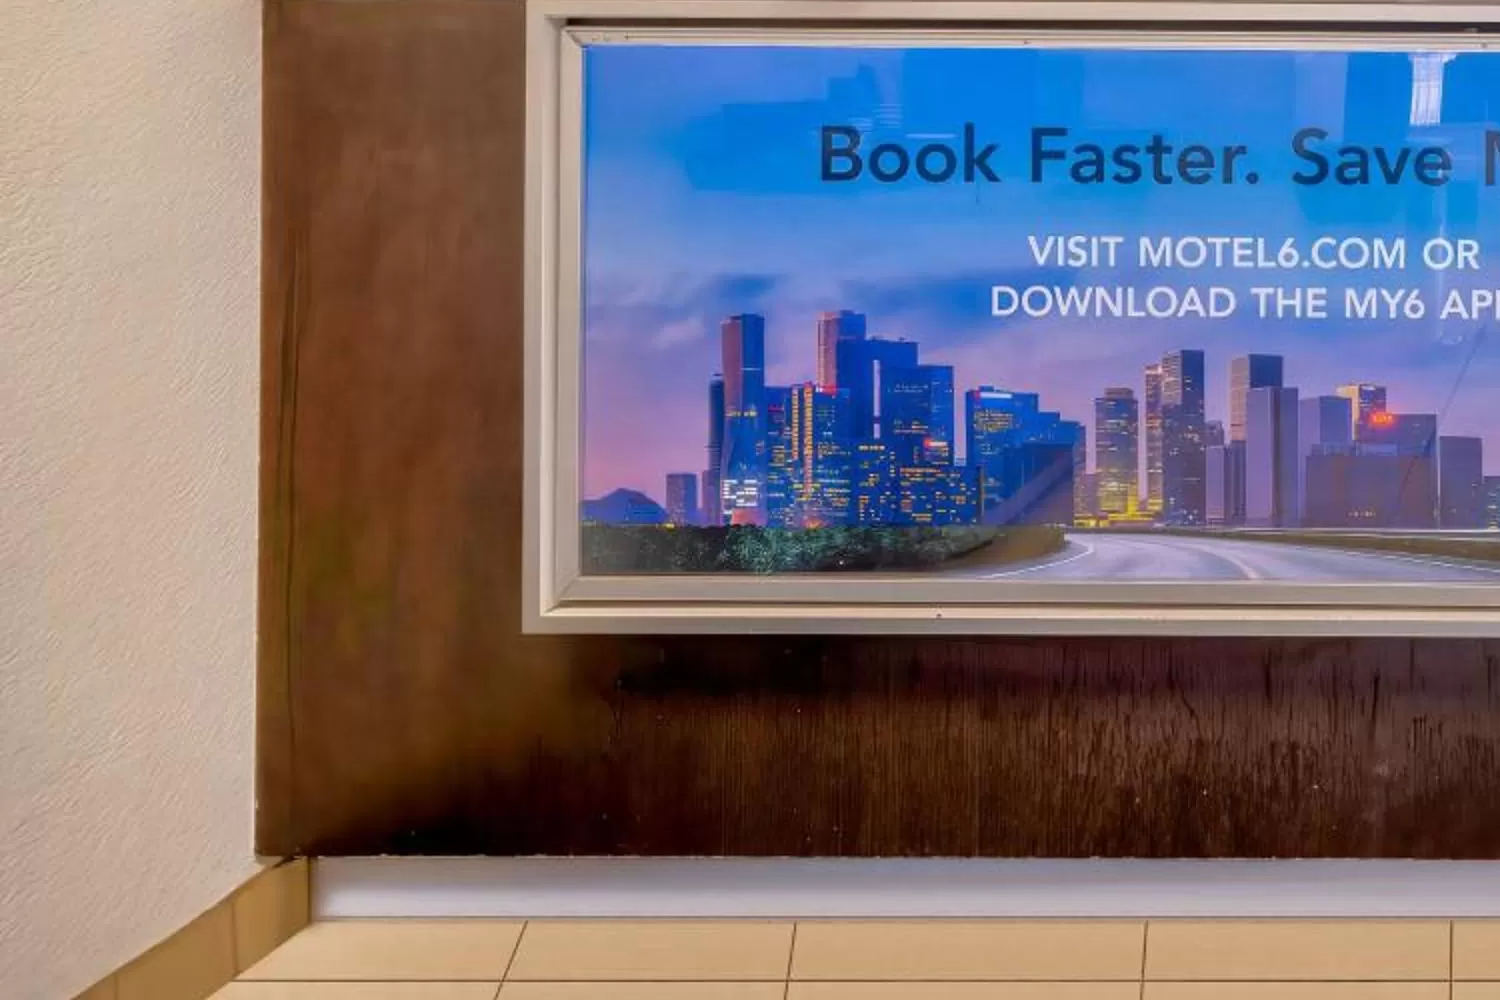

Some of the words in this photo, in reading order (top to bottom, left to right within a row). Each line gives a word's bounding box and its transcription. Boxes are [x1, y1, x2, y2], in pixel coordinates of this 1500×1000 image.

[820, 122, 1001, 183] Book
[1030, 126, 1259, 185] Faster.
[1291, 127, 1453, 186] Save
[1028, 235, 1124, 268] VISIT
[1139, 236, 1406, 270] MOTEL6.COM
[1423, 237, 1480, 270] OR
[991, 286, 1236, 318] DOWNLOAD
[1250, 287, 1328, 319] THE
[1344, 289, 1425, 320] MY6
